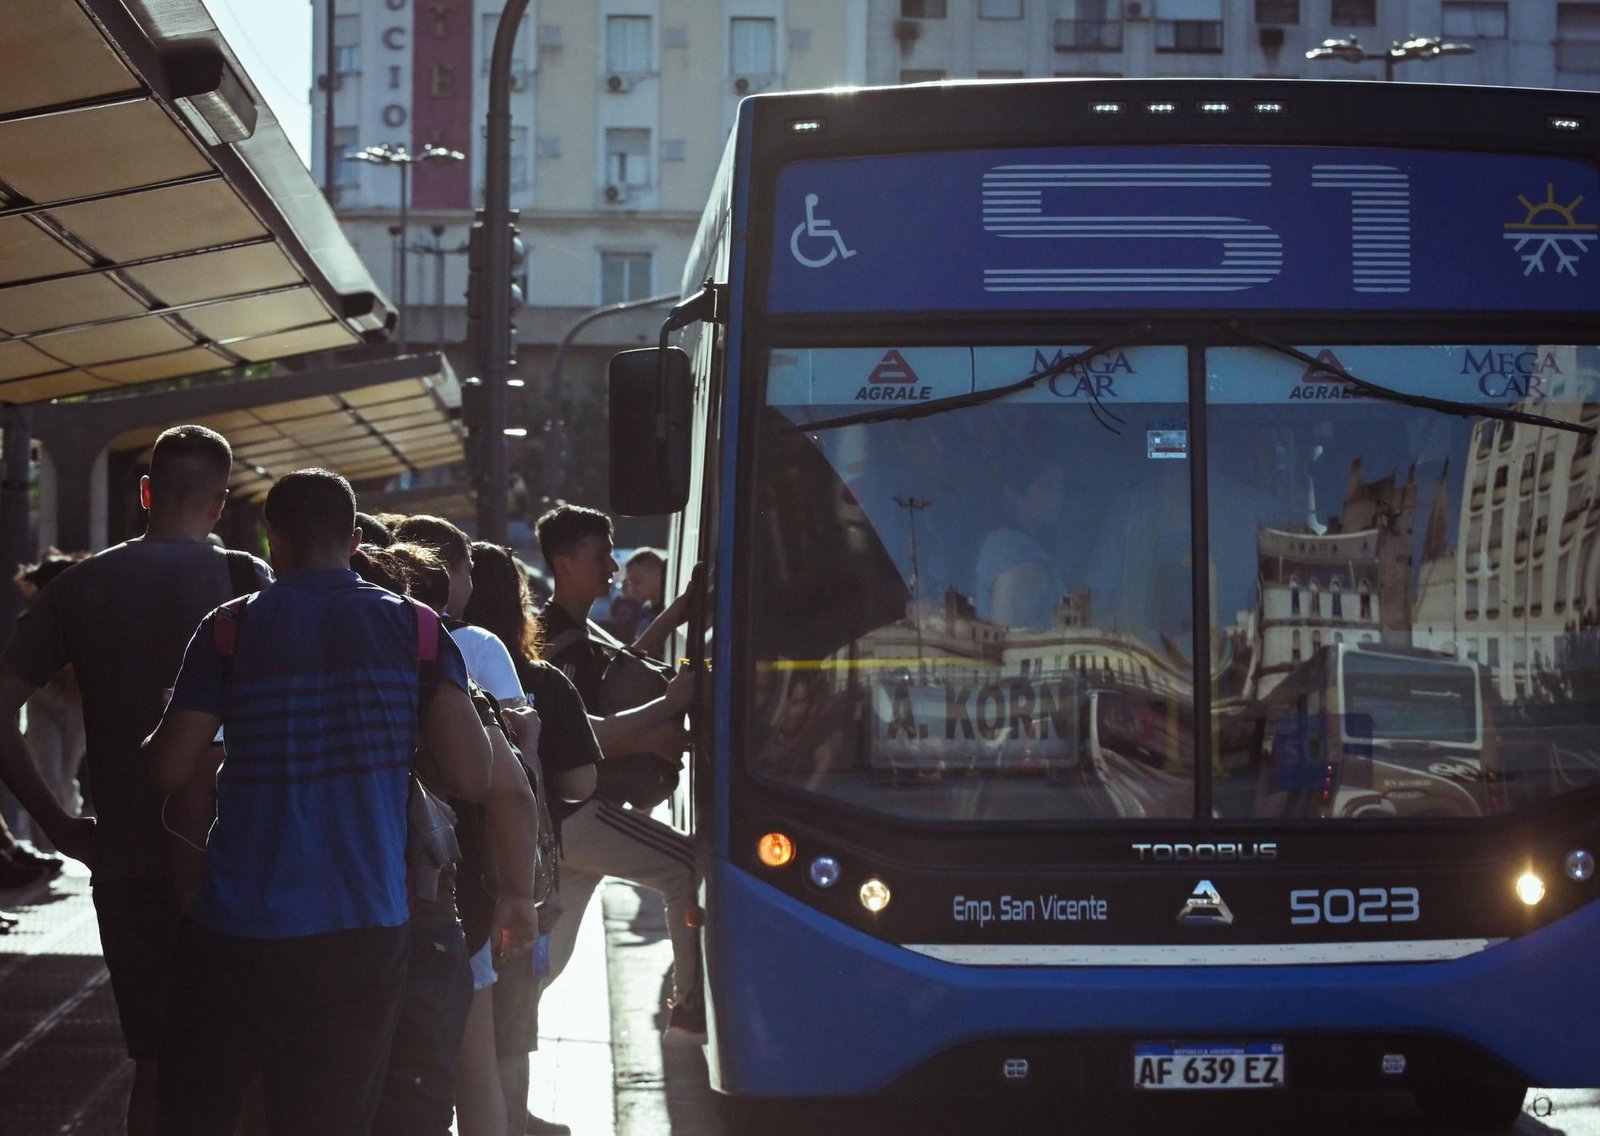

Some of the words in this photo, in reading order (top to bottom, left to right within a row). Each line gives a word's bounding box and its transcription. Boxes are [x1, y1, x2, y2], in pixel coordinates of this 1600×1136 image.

[982, 164, 1411, 293] 51
[1459, 348, 1564, 374] MEGA
[854, 386, 932, 401] AGRALE
[1048, 372, 1119, 398] CAR
[1478, 372, 1548, 398] CAR
[887, 681, 929, 739] A.
[944, 681, 1069, 740] KORN
[1132, 843, 1278, 861] TODOBUS
[953, 896, 995, 928] Emp.
[1001, 896, 1036, 921] San
[1040, 893, 1108, 921] Vicente
[1290, 887, 1420, 925] 5023
[1139, 1057, 1173, 1084] AF
[1183, 1057, 1235, 1084] 639
[1244, 1056, 1279, 1083] EZ
